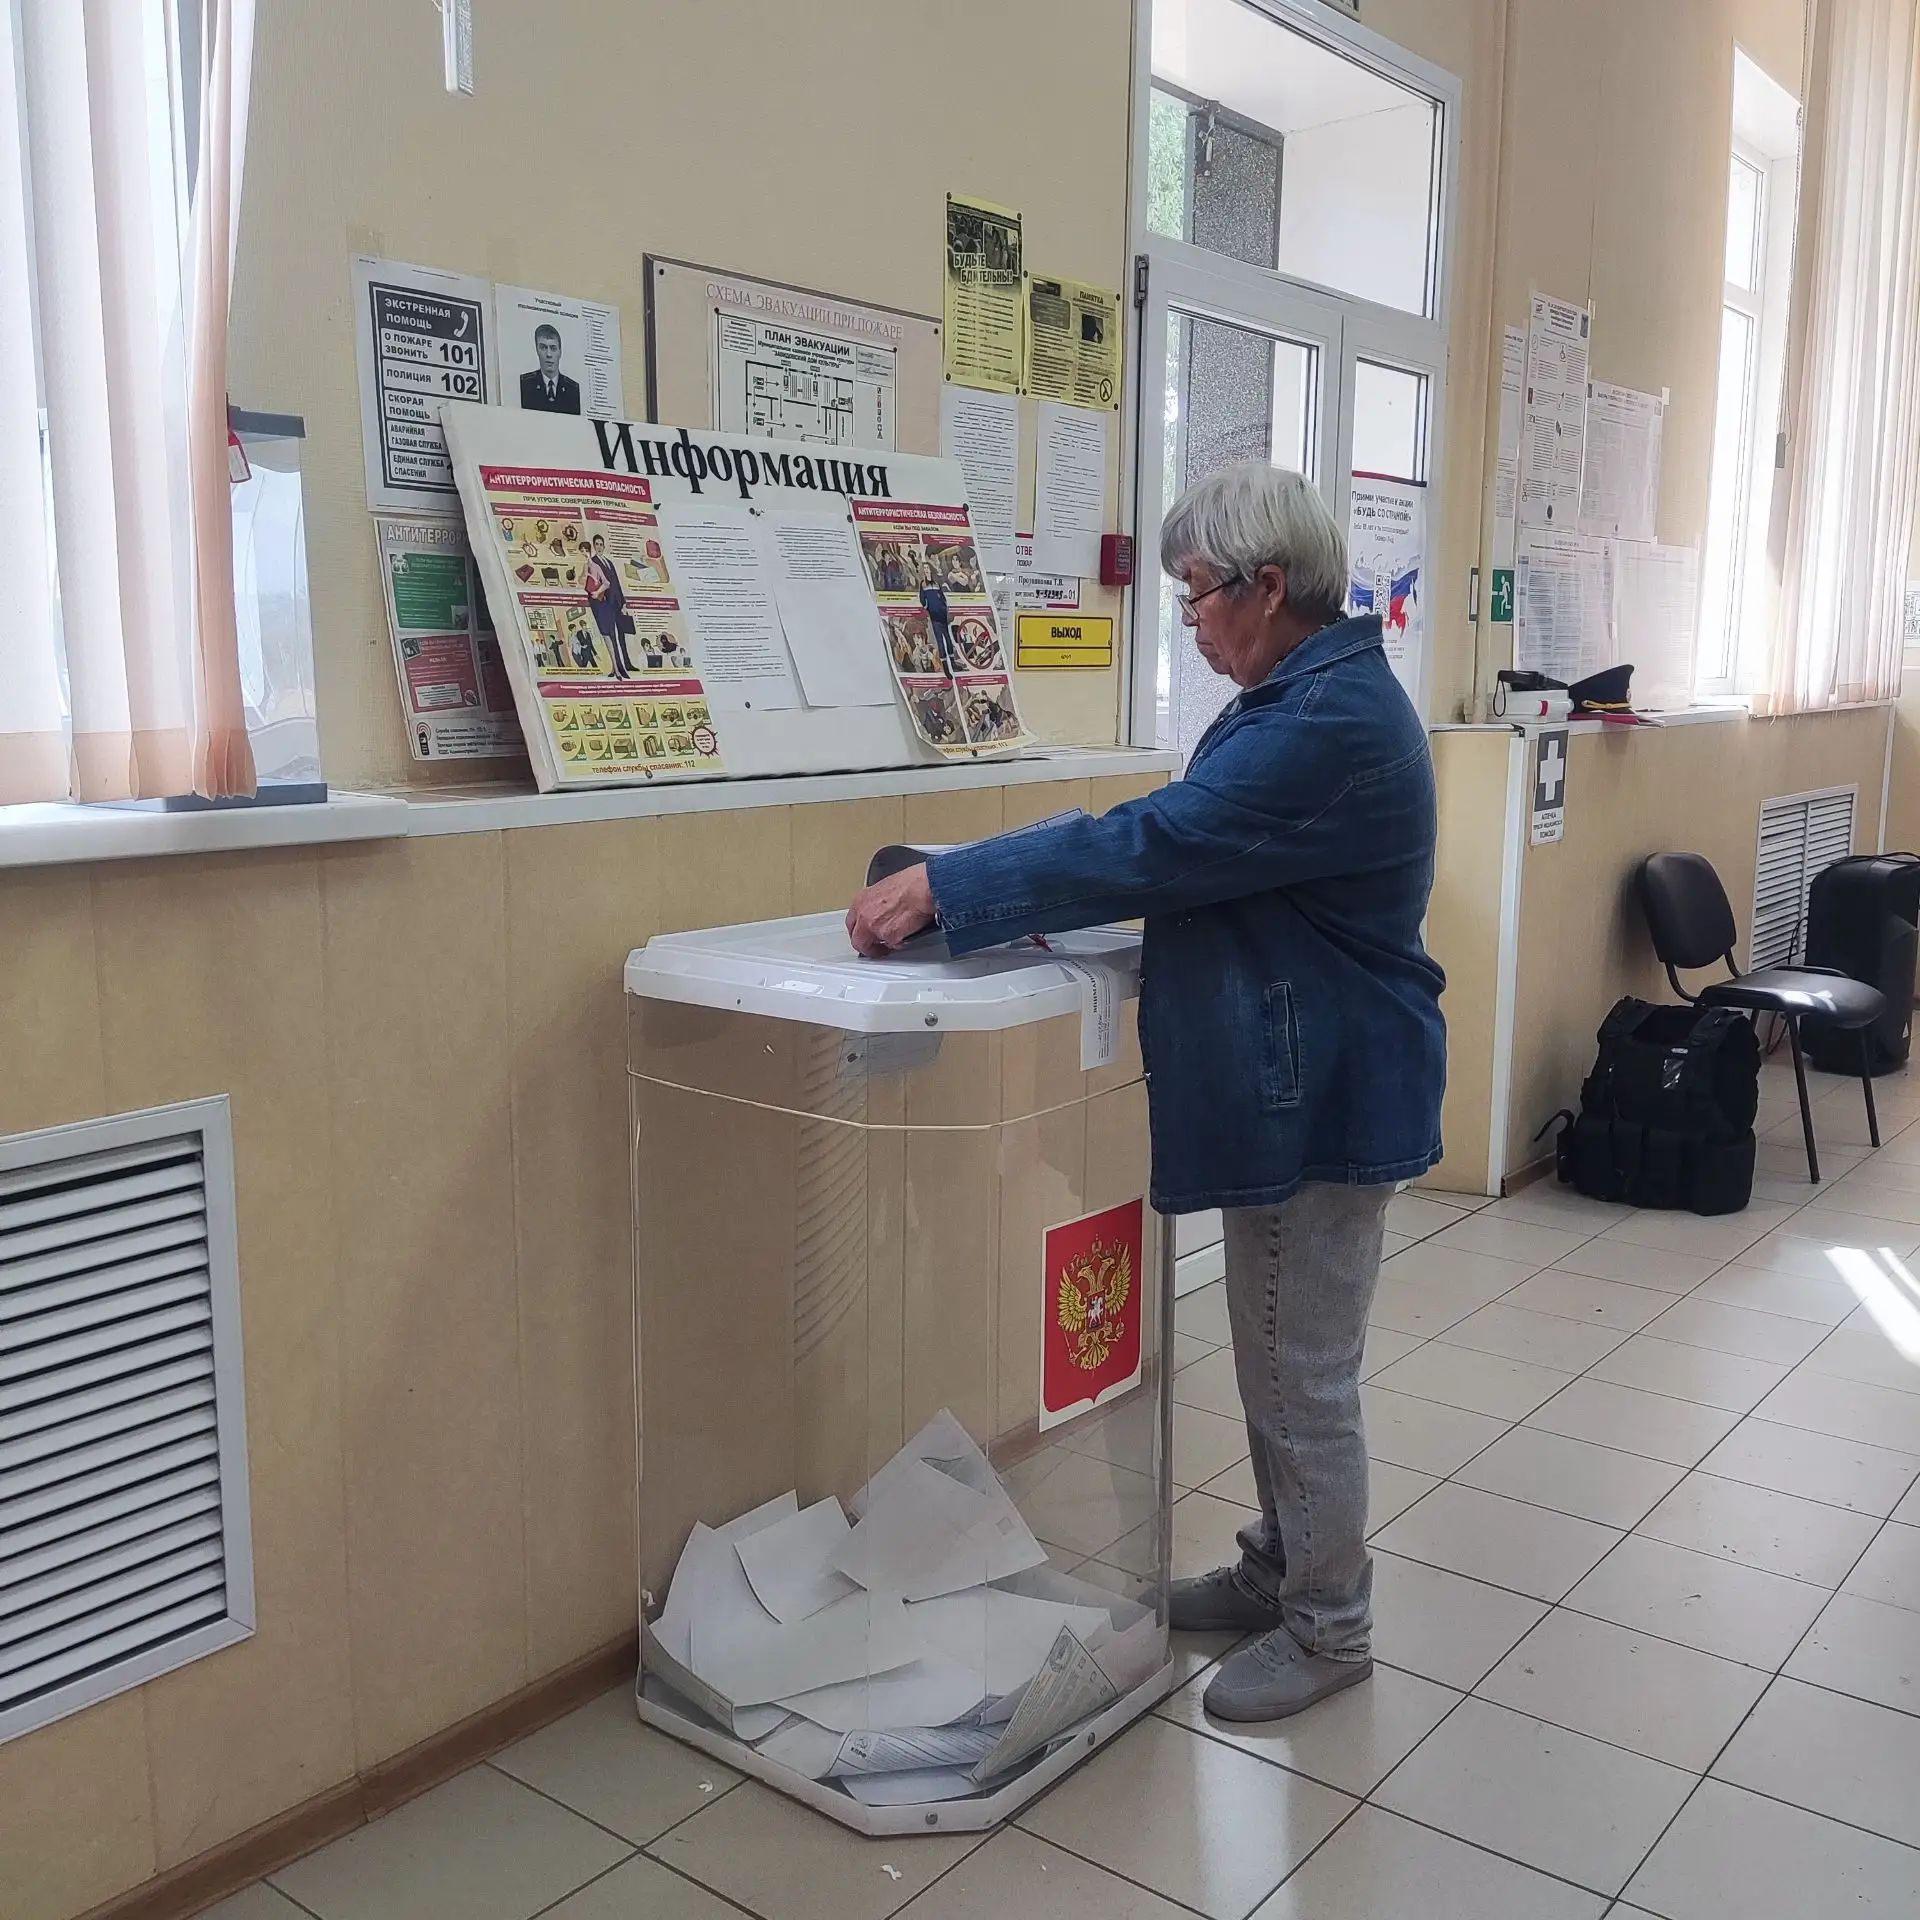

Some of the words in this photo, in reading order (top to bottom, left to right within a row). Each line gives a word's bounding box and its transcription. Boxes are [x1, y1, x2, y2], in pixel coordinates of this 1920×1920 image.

[955, 253, 986, 268] БУДЬТЕ
[384, 298, 451, 318] ЭКСТРЕННАЯ
[706, 283, 751, 307] СХЕМА
[757, 294, 831, 322] ЭВАКУАЦИИ
[834, 312, 853, 327] ПРИ
[856, 318, 902, 340] ПОЖАРЕ
[386, 313, 432, 330] ПОМОЩЬ
[385, 332, 391, 341] О
[394, 333, 432, 348] ПОЖАРЕ
[765, 330, 791, 344] ПЛАН
[795, 336, 850, 356] ЭВАКУАЦИИ
[385, 345, 428, 359] ЗВОНИТЬ
[440, 342, 473, 366] 101
[386, 368, 431, 383] ПОЛИЦИЯ
[441, 372, 478, 395] 102
[388, 394, 424, 406] СКОРАЯ
[389, 406, 430, 420] ПОМОЩЬ
[390, 424, 426, 436] АВАРИЙНАЯ
[391, 436, 417, 447] ГАЗОВАЯ
[419, 440, 443, 450] СЛУЖБА
[393, 454, 417, 465] ЕДИНАЯ
[420, 457, 444, 468] СЛУЖБА
[587, 418, 893, 500] Информация
[394, 467, 427, 478] СПАСЕНИЯ
[489, 473, 595, 489] АНТИТЕРРОРИСТИЧЕСКАЯ
[595, 479, 646, 496] БЕЗОПАСНОСТЬ
[1352, 490, 1374, 503] Прими
[858, 506, 927, 519] АНТИТЕРРОРИСТИЧЕСКАЯ
[927, 511, 966, 522] БЕЗОПАСНОСТЬ
[1015, 545, 1032, 556] ОТВЕ
[1051, 626, 1082, 640] ВЫХОД
[592, 764, 621, 775] телефон
[684, 759, 696, 768] 112
